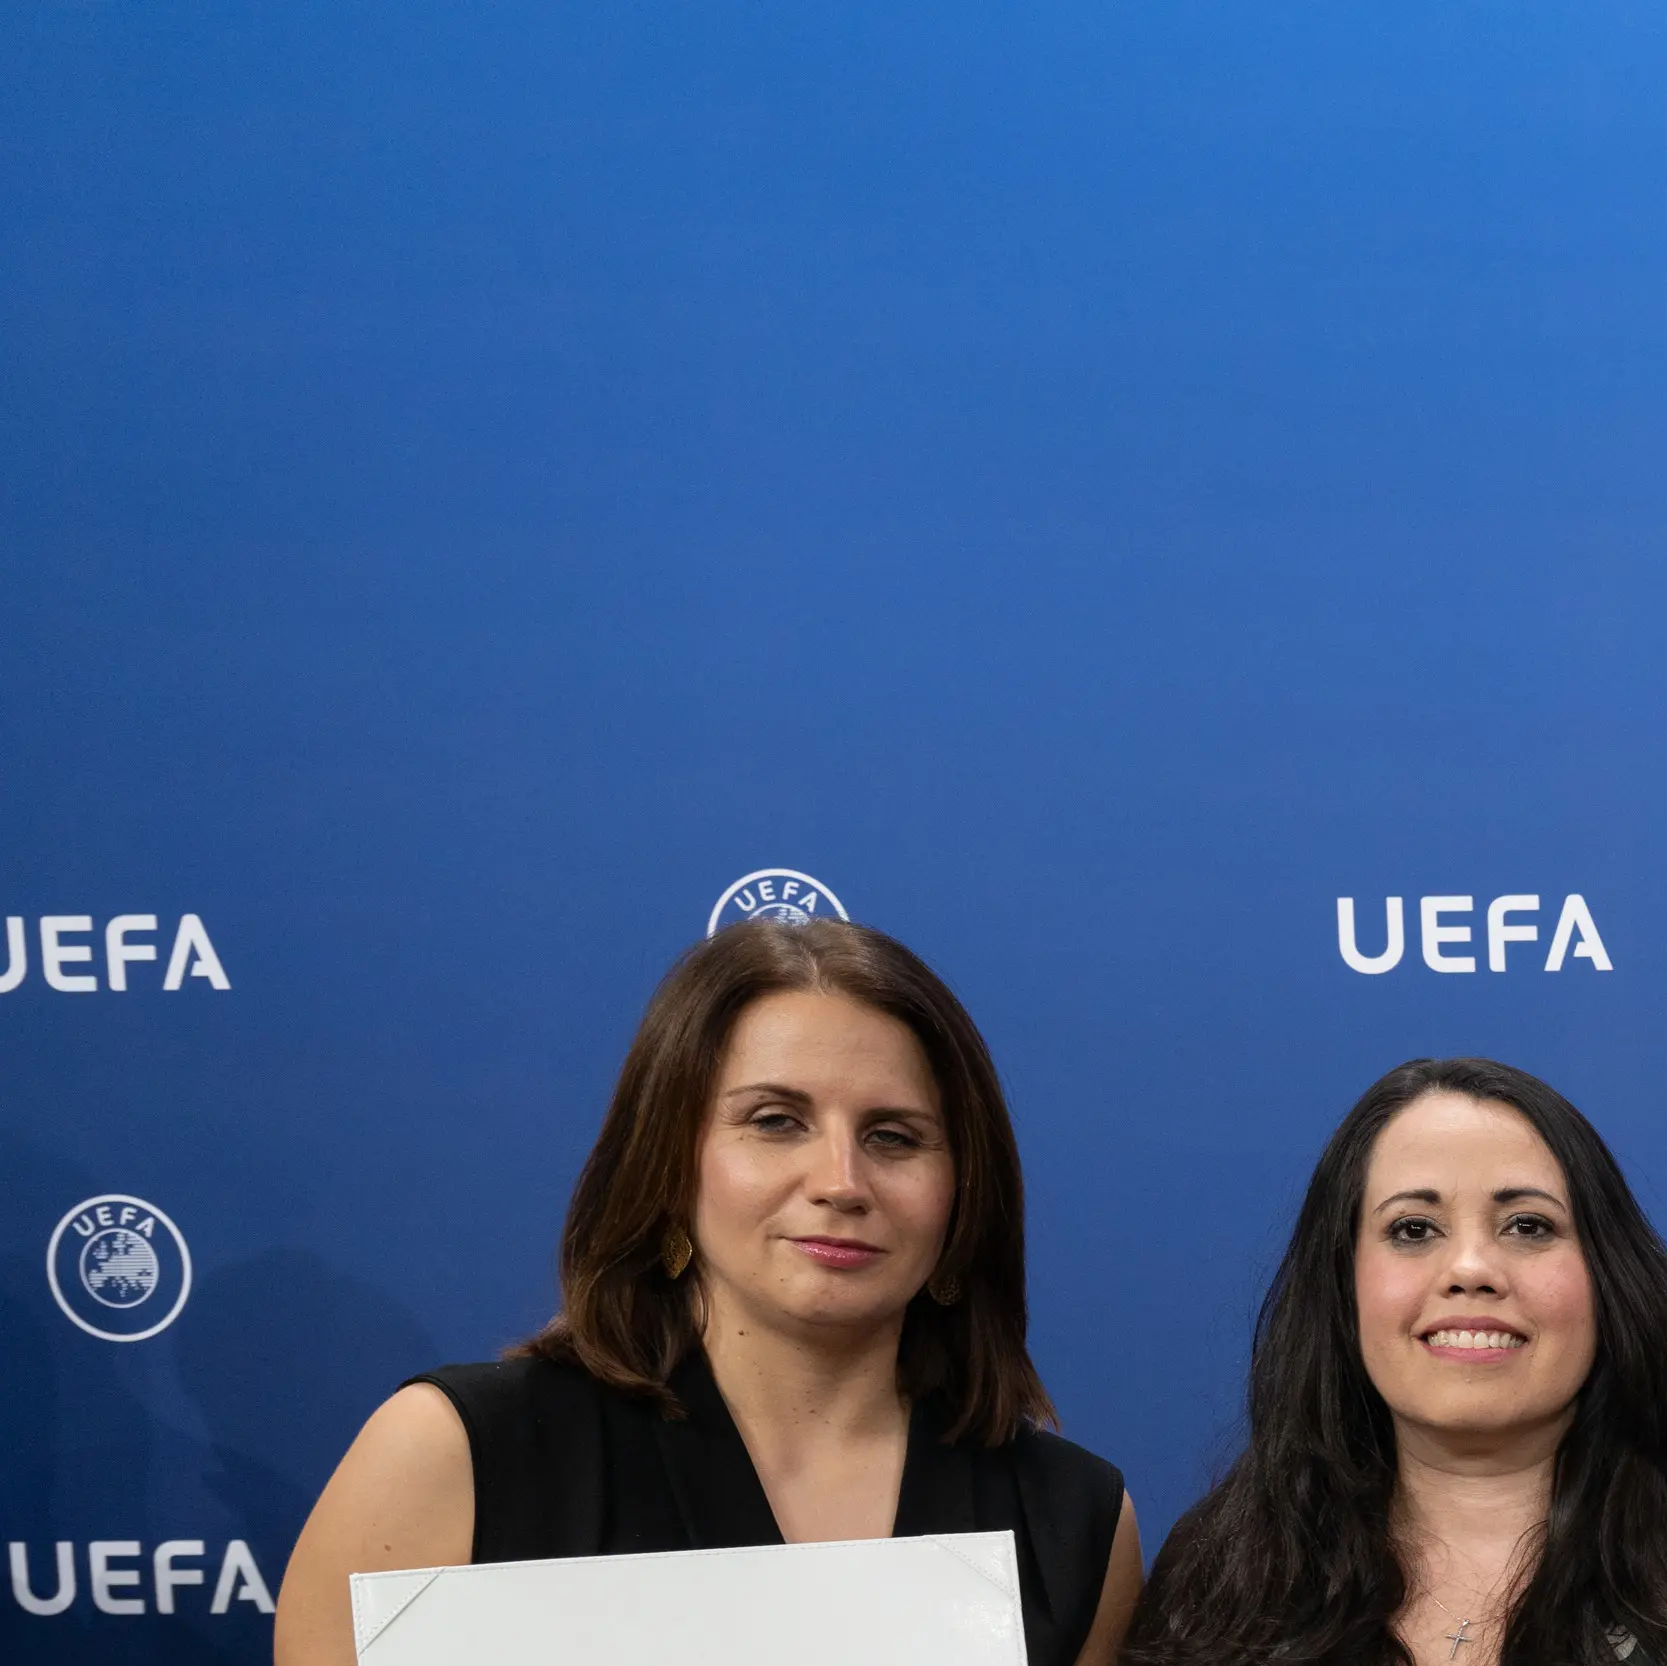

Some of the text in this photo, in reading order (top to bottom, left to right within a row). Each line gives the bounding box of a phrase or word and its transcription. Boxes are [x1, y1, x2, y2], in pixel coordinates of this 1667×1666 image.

[734, 880, 817, 913] UEFA
[1337, 894, 1613, 974] UEFA
[72, 1206, 155, 1238] UEFA
[9, 1539, 276, 1616] UEFA
